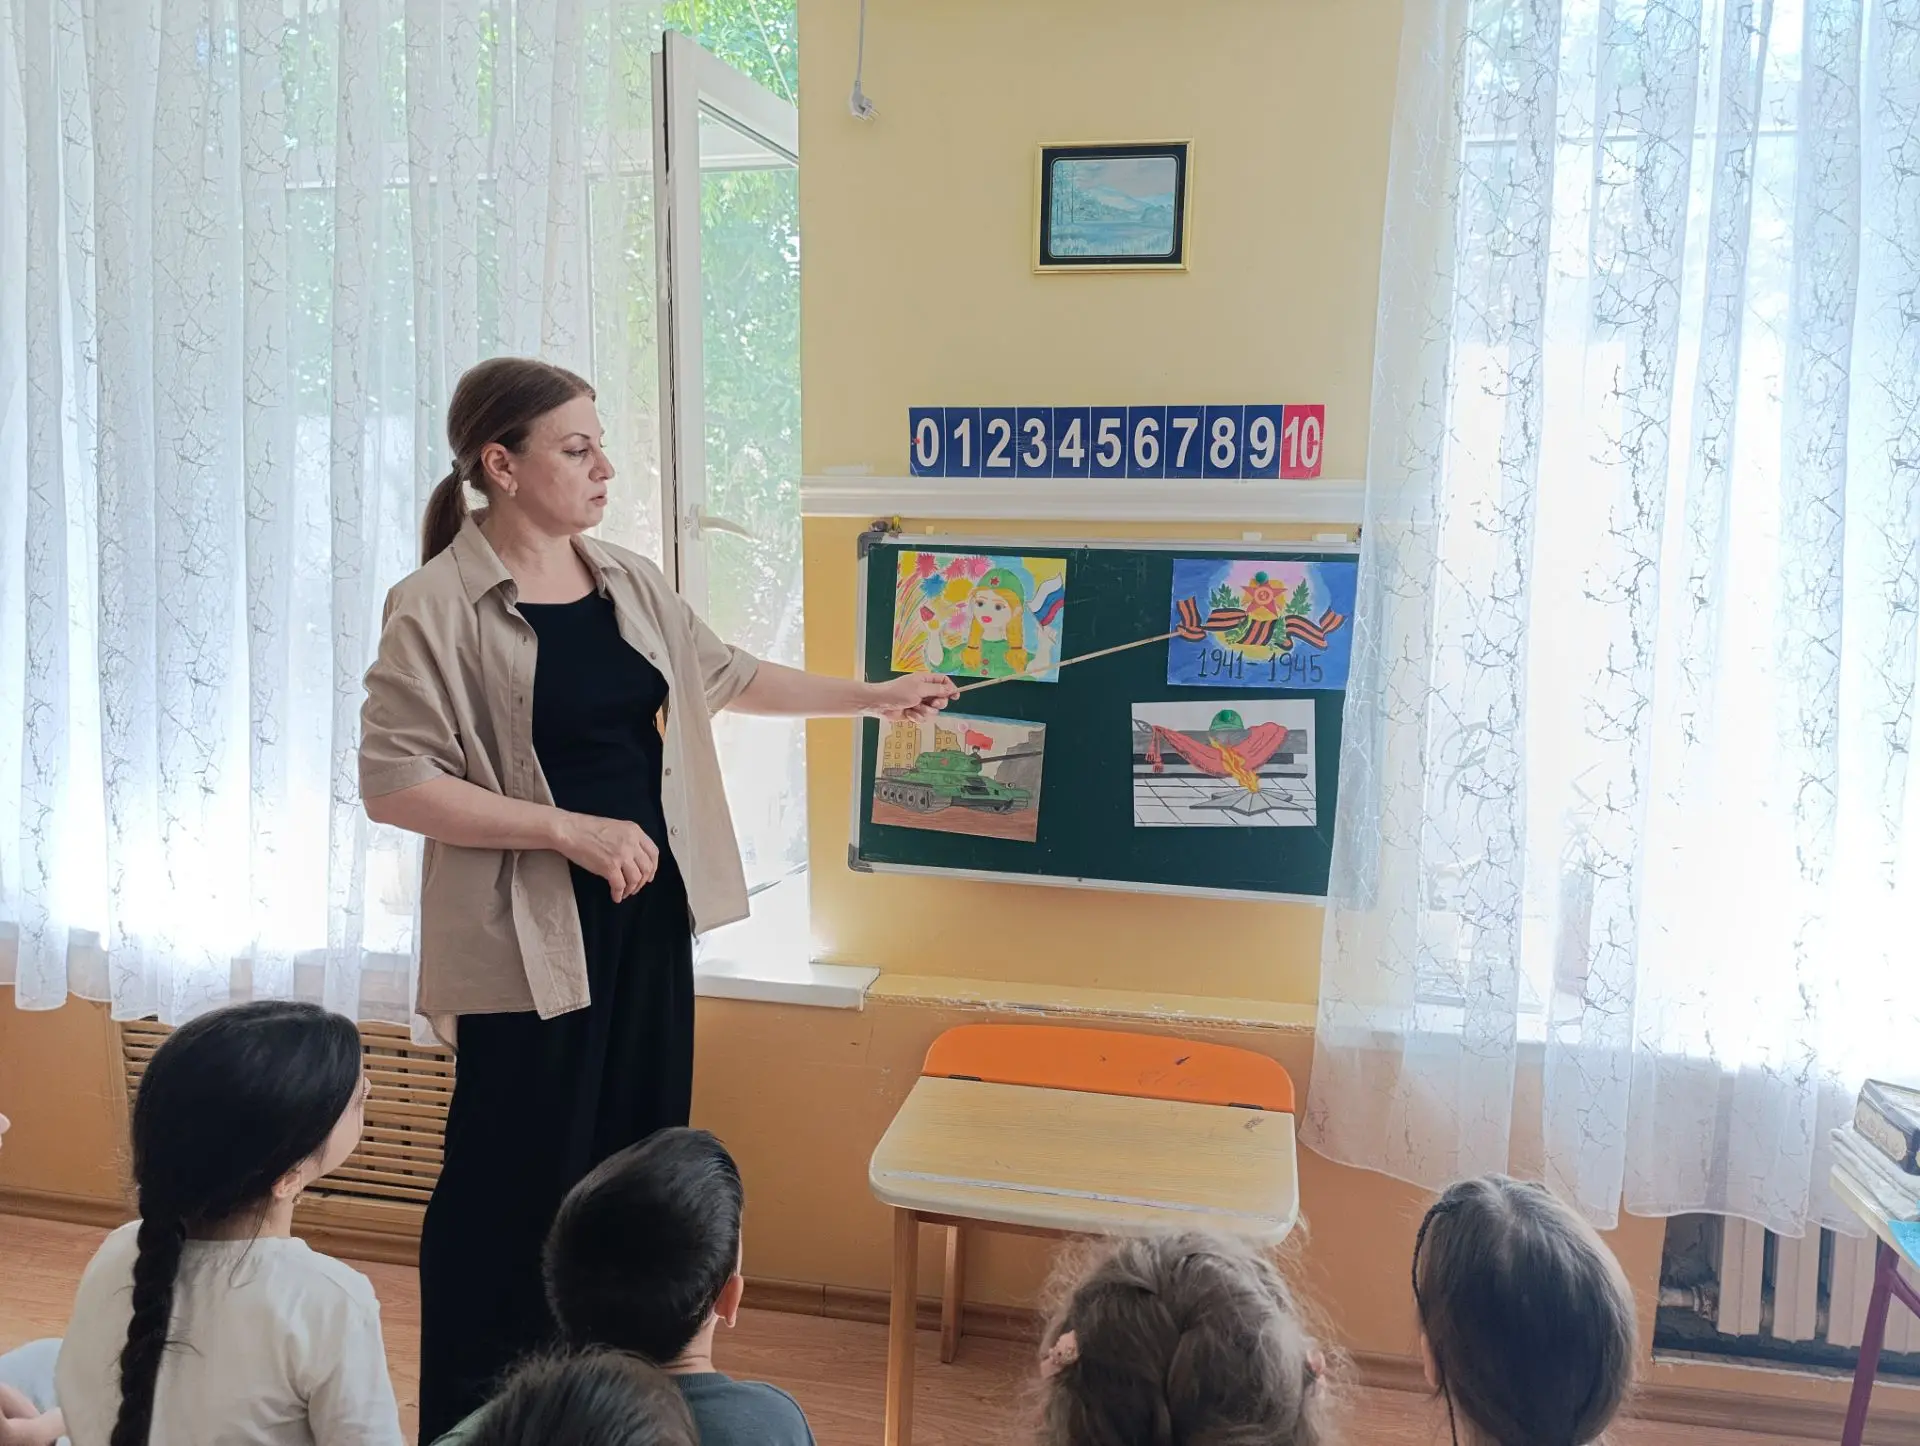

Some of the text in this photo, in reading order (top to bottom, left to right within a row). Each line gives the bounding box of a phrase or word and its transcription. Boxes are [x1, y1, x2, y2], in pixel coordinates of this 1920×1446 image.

[916, 416, 1319, 468] 0 1 2 3 4 5 6 7 8 9 10
